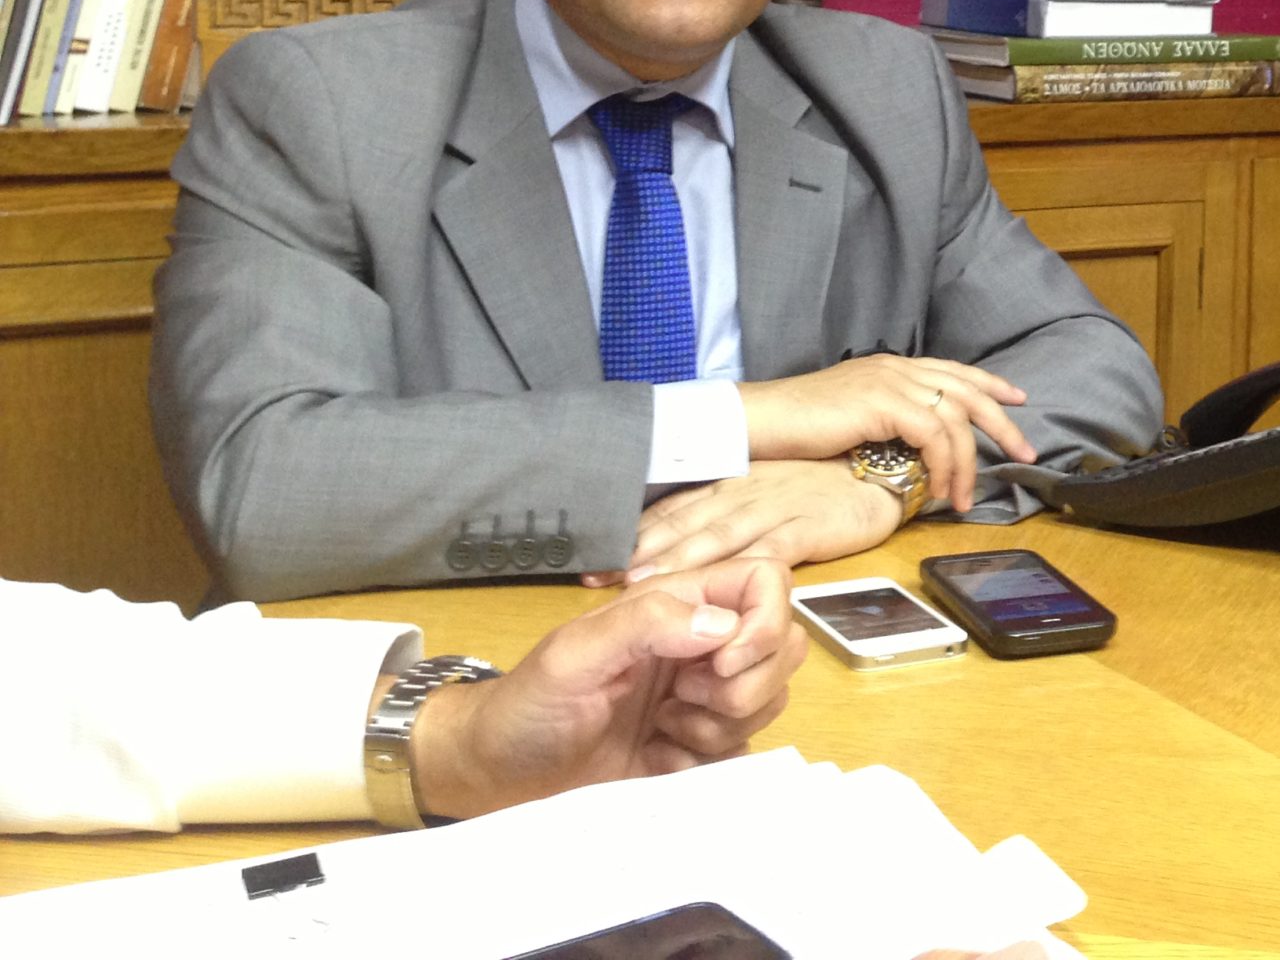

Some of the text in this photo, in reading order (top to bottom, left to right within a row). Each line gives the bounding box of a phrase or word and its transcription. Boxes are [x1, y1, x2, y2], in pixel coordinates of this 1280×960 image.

[1082, 40, 1230, 58] ΕΛΛΑΣ ΑΝΩΘΕΝ
[1043, 83, 1082, 96] ΣΑΜΟΣ
